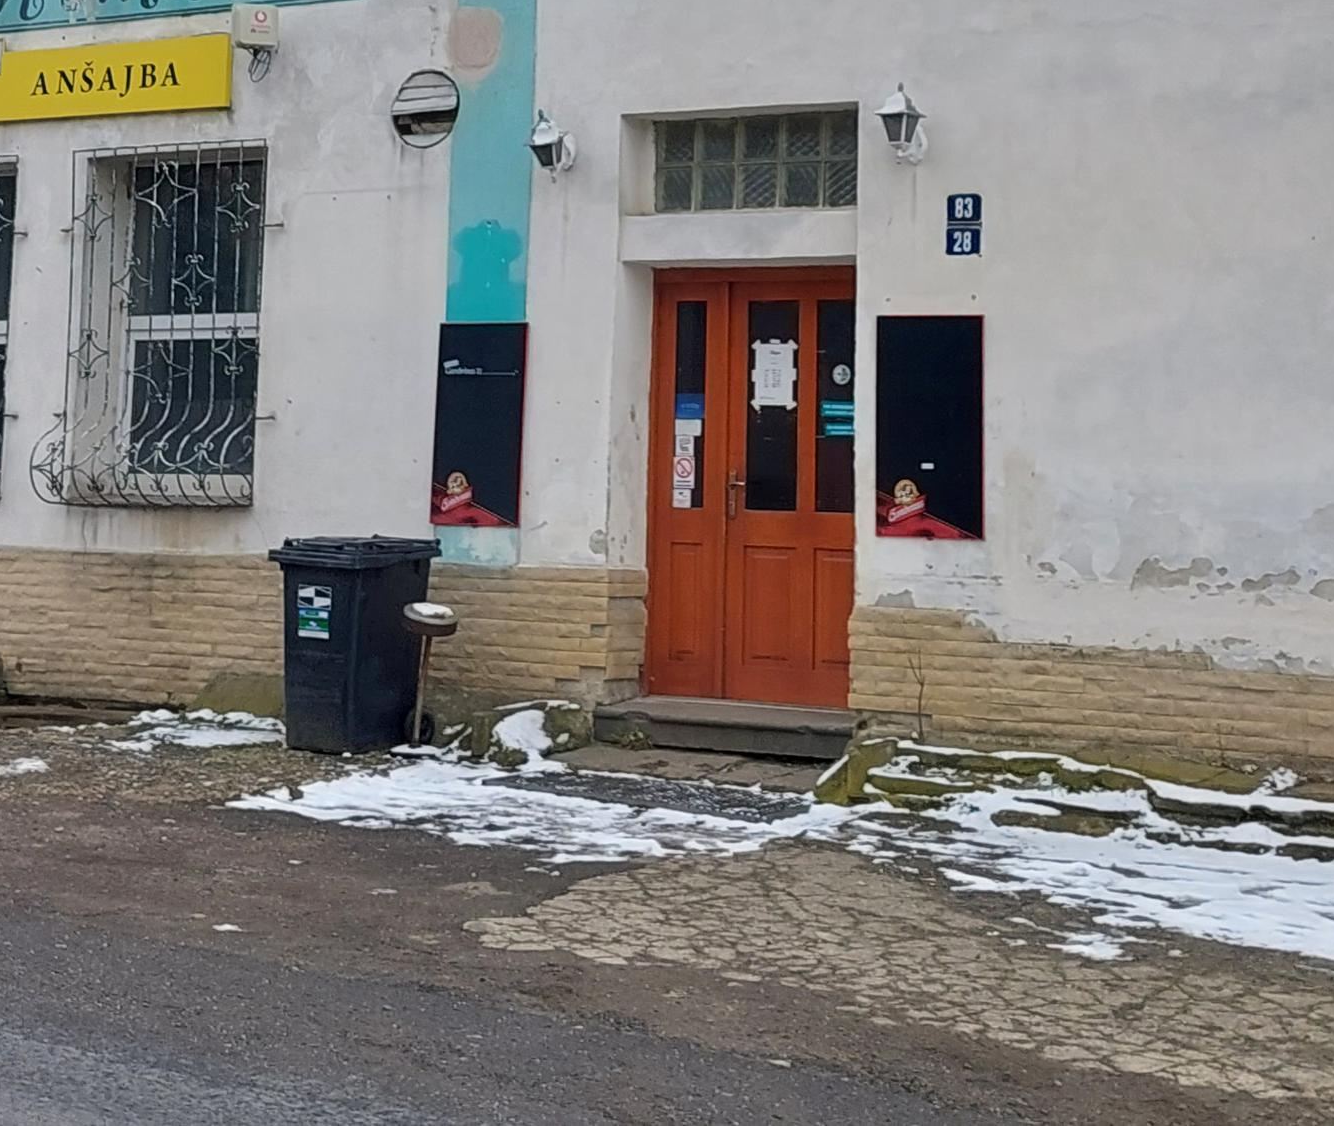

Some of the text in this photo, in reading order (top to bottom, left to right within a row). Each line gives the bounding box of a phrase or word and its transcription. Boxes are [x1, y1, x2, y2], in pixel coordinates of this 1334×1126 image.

[30, 60, 181, 98] ANŠAJBA
[954, 197, 974, 219] 83
[952, 231, 972, 252] 28
